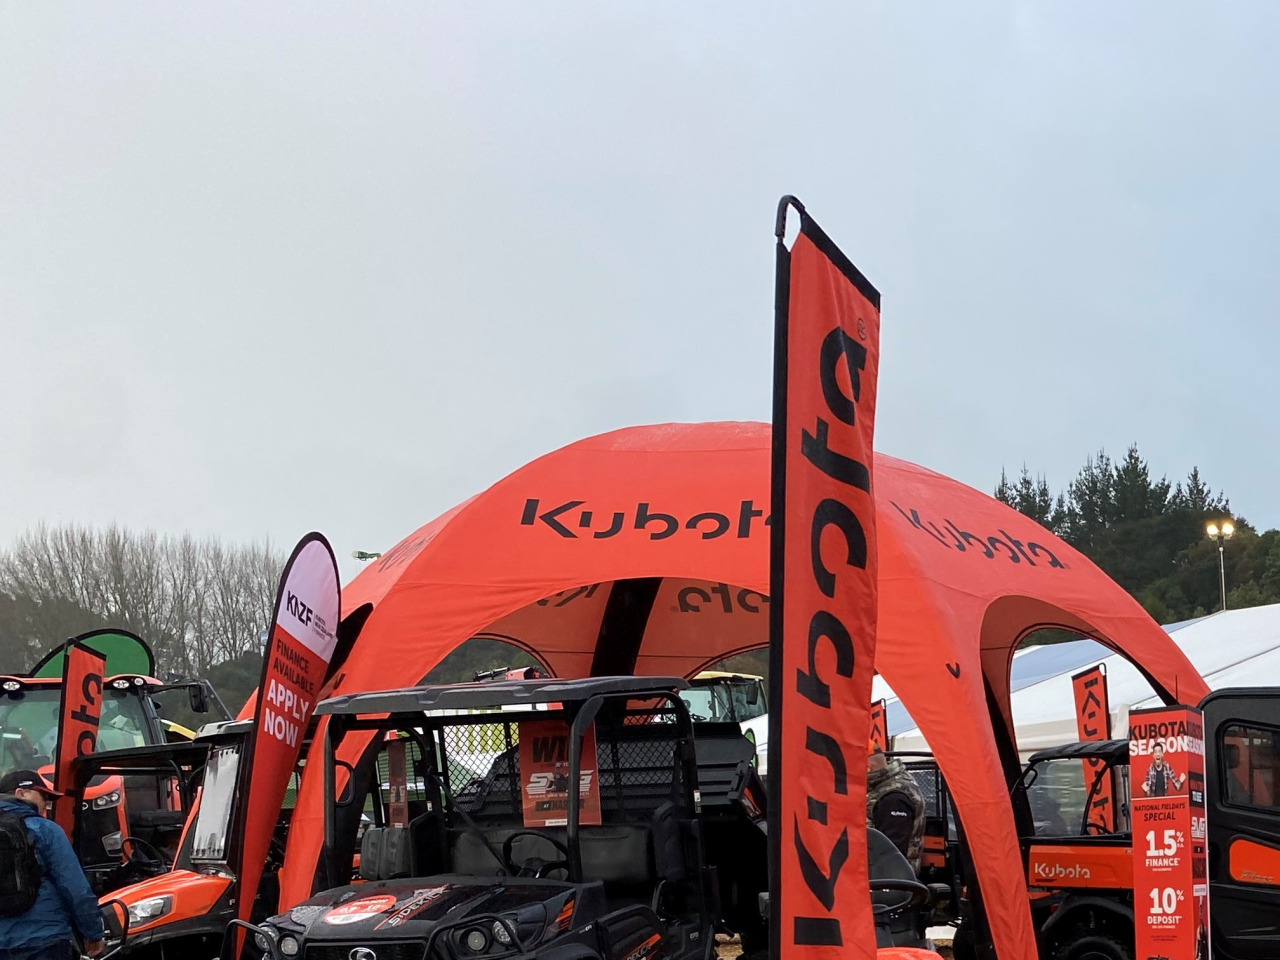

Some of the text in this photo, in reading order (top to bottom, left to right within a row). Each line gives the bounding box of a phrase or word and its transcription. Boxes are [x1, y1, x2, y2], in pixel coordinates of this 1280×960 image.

[520, 499, 771, 540] Kubot
[890, 500, 1065, 569] Kubota
[793, 325, 871, 948] Kubota
[276, 639, 309, 674] FINANCE
[267, 679, 309, 722] APPLY
[264, 708, 299, 747] NOW
[1129, 721, 1187, 740] KUBOTA
[1129, 736, 1188, 756] SEASON
[1144, 812, 1176, 821] SPECIAL
[1035, 863, 1090, 878] Kubota
[1146, 858, 1180, 867] FINANCE
[1147, 915, 1182, 924] DEPOSIT
